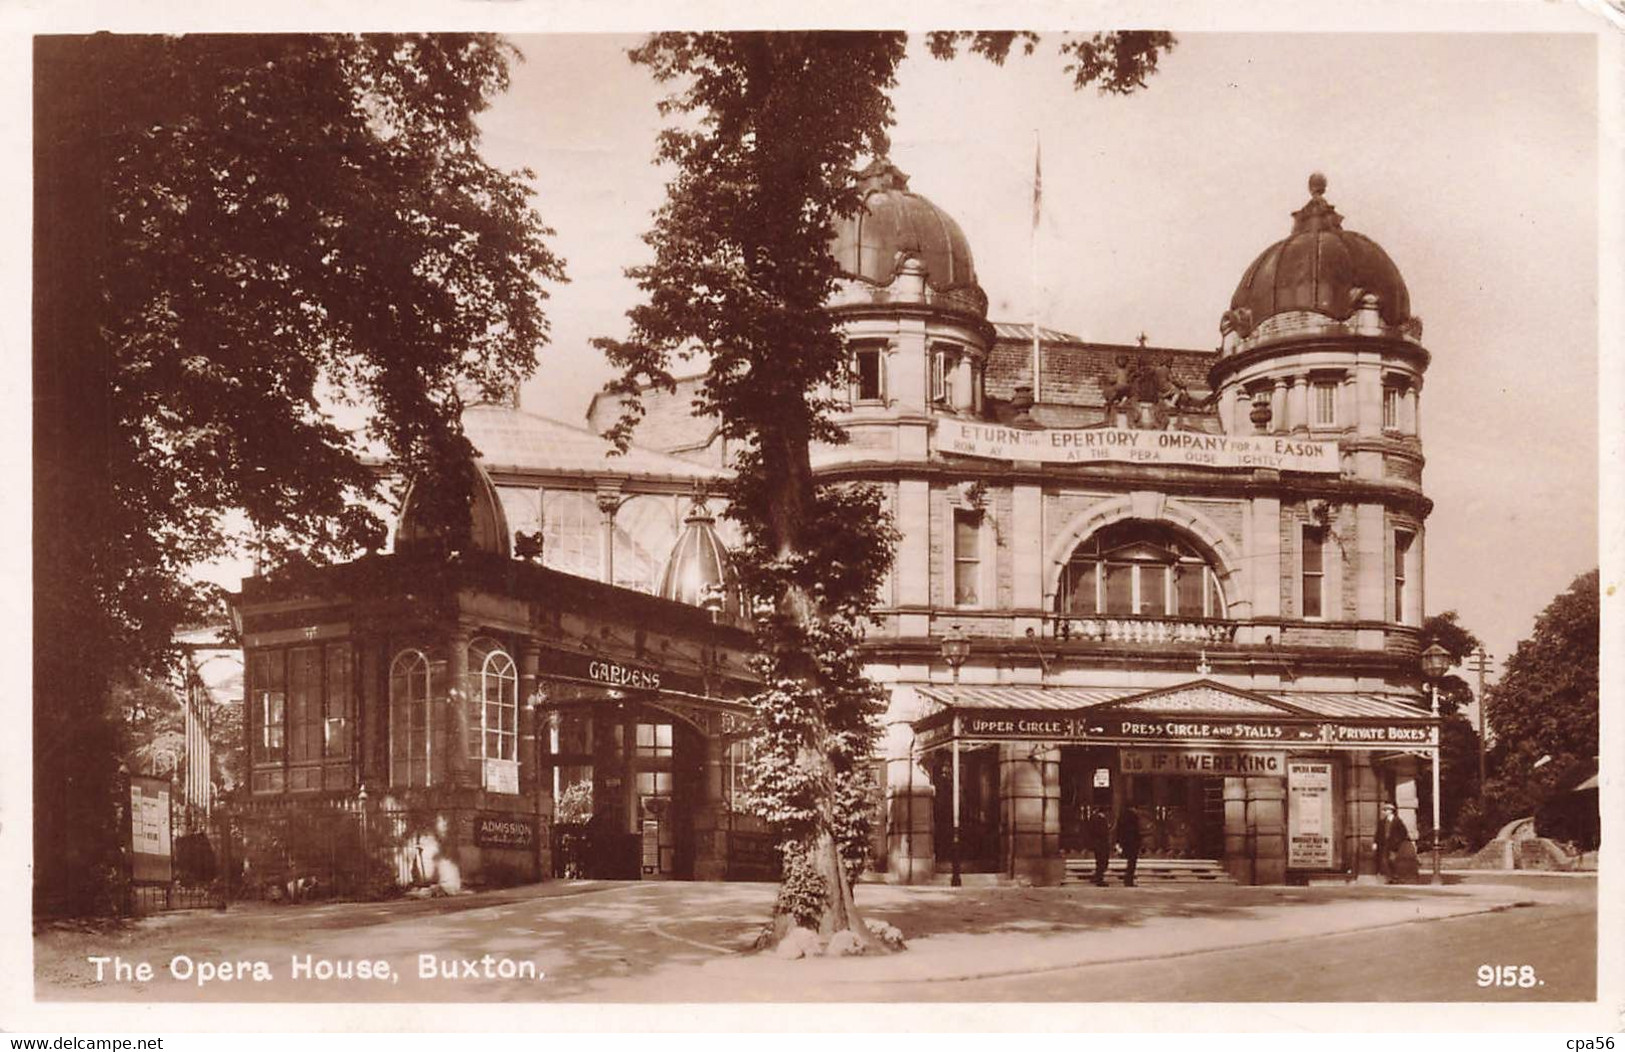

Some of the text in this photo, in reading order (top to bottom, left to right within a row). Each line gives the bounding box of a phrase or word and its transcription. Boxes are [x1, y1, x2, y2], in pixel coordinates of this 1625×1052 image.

[1051, 431, 1139, 447] EPERTORY
[1158, 433, 1228, 450] OMPANY
[1275, 440, 1323, 458] EASON
[589, 660, 660, 688] GARDENS
[972, 719, 1061, 732] UPPER CIRCLE
[1121, 721, 1282, 738] DRESS CIRCLE AND STALLS
[1338, 726, 1426, 740] PRIVATE BOXES
[1236, 752, 1277, 772] KING
